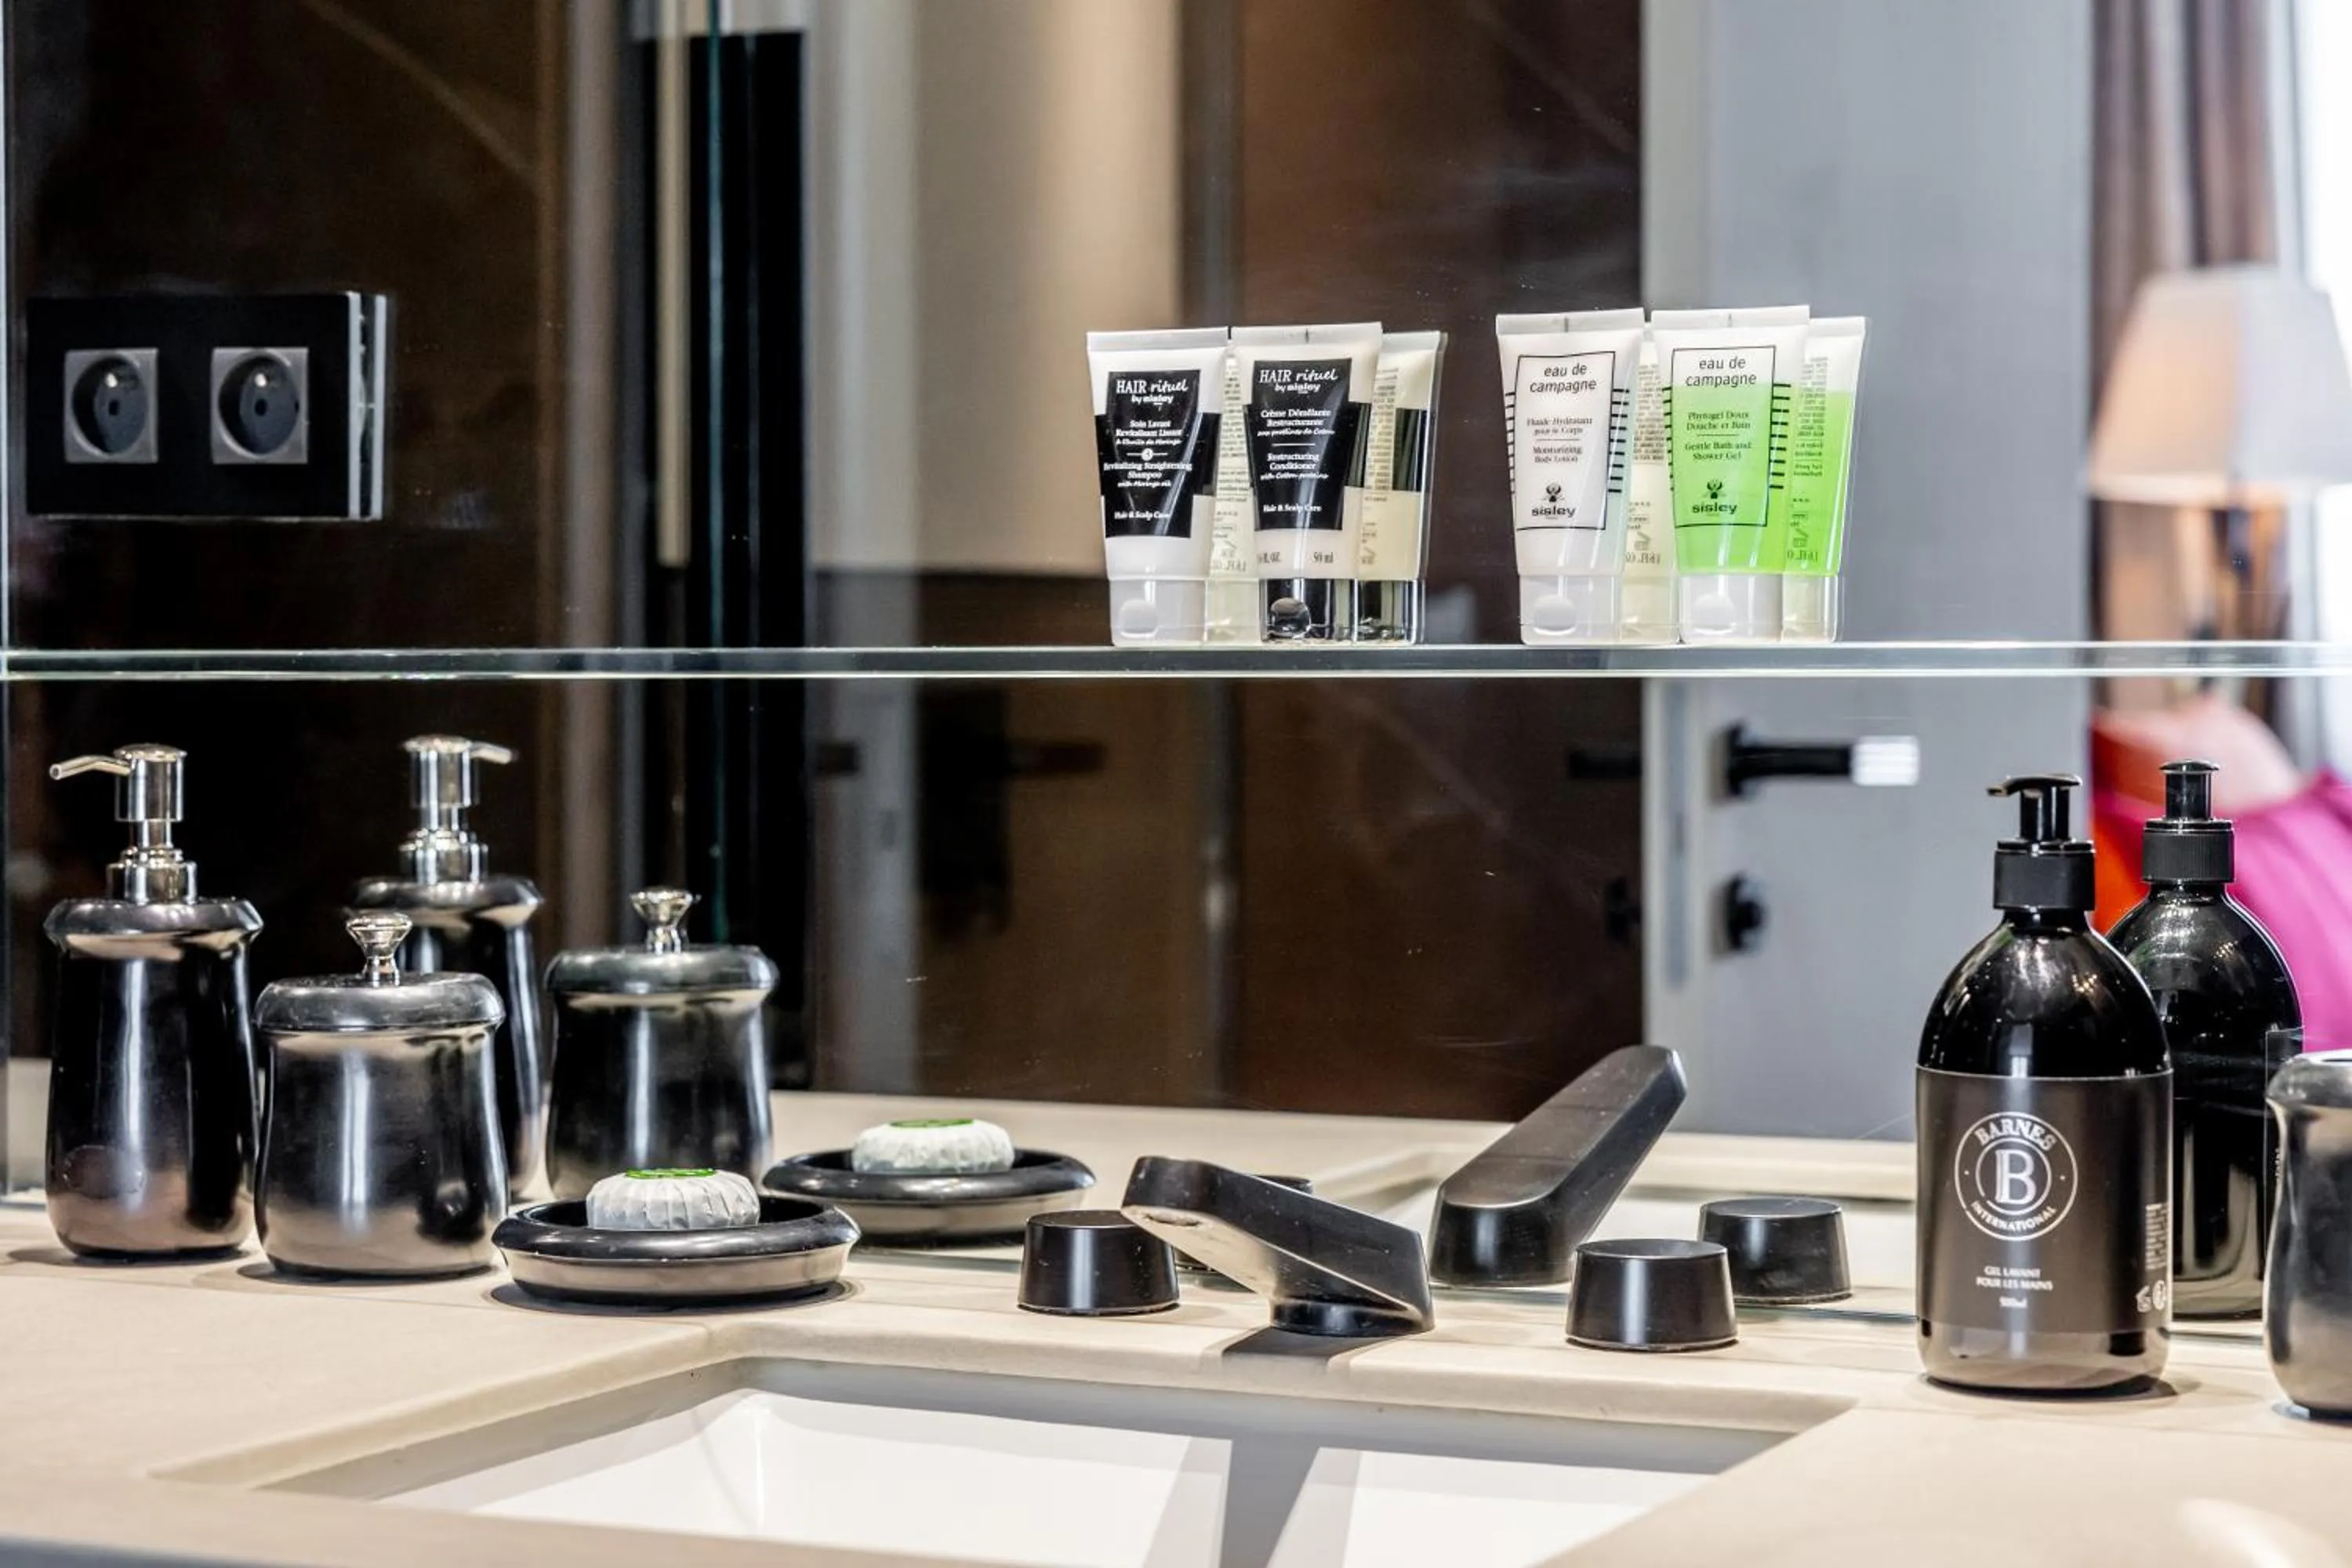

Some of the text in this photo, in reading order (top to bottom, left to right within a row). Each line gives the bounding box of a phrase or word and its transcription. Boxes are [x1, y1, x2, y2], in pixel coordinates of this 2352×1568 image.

[1699, 356, 1746, 369] eau de
[1259, 368, 1338, 383] HAIR rituel
[1544, 363, 1588, 377] eau de
[1116, 379, 1189, 394] HAIR rituel
[1530, 379, 1597, 394] campagne
[1686, 374, 1757, 388] campagne
[1275, 383, 1286, 393] by
[1131, 394, 1142, 405] by
[1686, 422, 1717, 430] Douche
[1726, 452, 1742, 460] Gel
[1269, 462, 1316, 470] Conditioner
[1127, 471, 1162, 481] Shampoo
[1531, 505, 1576, 518] sisley
[1692, 502, 1737, 515] sisley
[1136, 511, 1152, 521] Scalp
[1974, 1118, 2057, 1151] BARNES
[1994, 1149, 2037, 1205] B
[1971, 1200, 2057, 1232] INTERNATIONAL
[1984, 1265, 2001, 1276] GEL
[1976, 1276, 2001, 1288] POUR
[2002, 1278, 2020, 1290] LES
